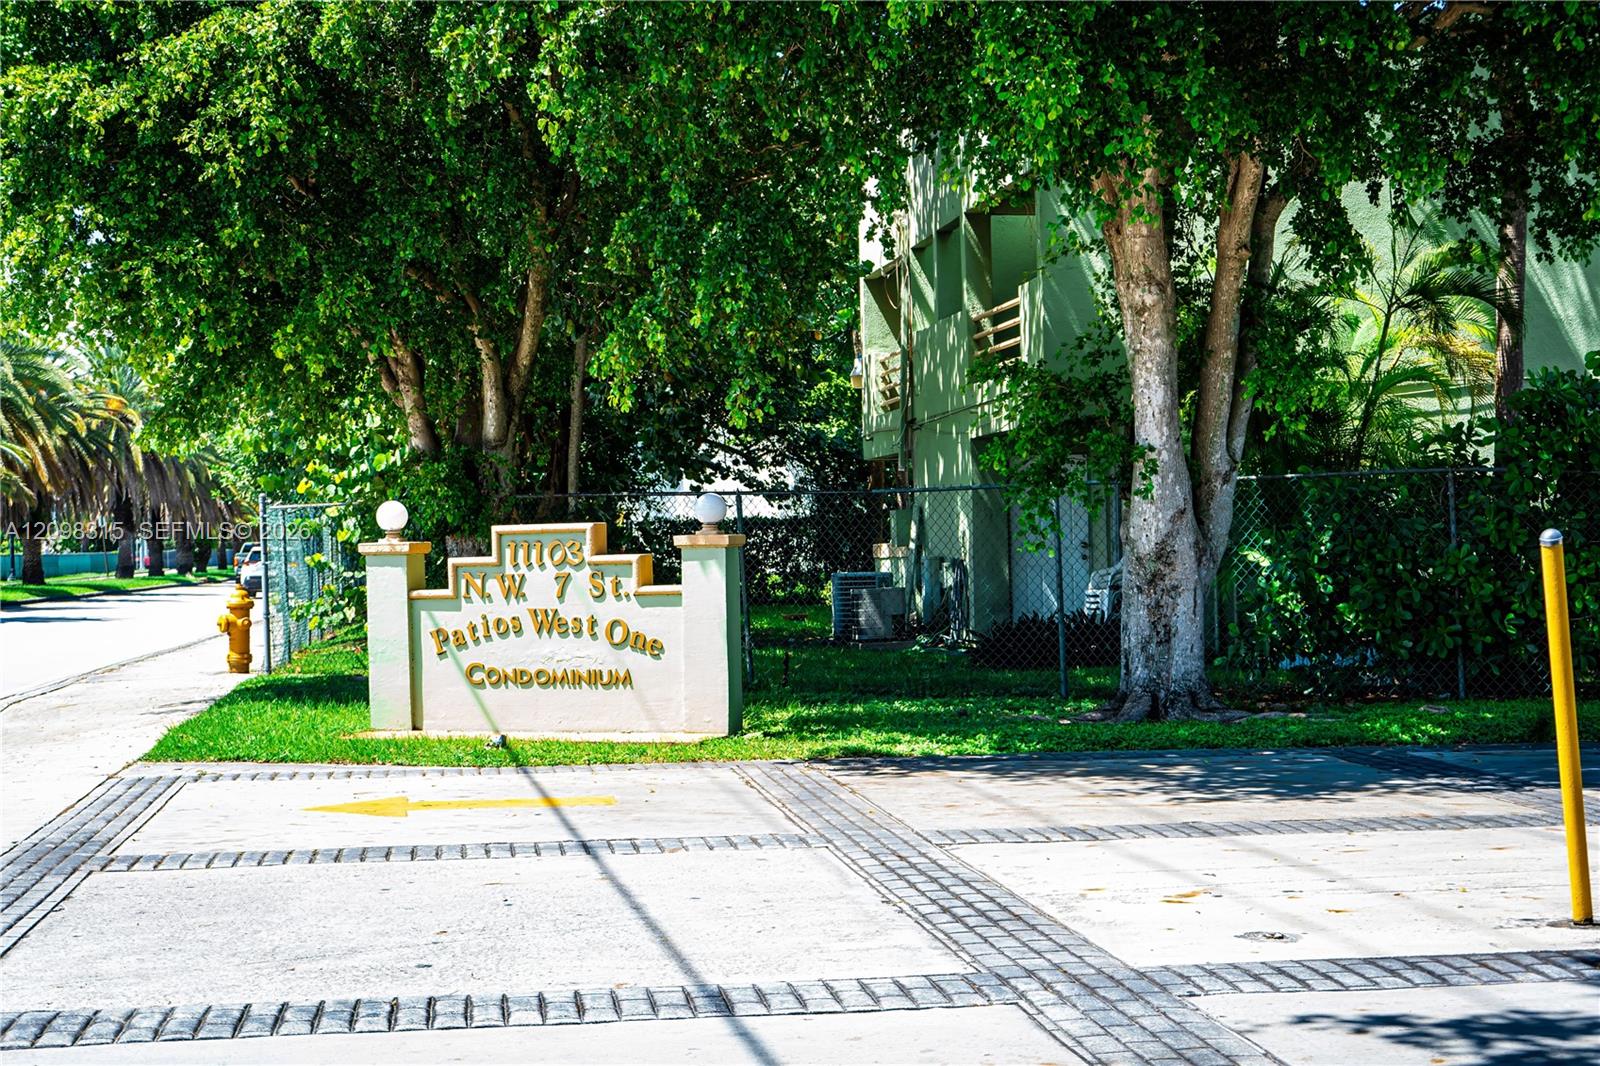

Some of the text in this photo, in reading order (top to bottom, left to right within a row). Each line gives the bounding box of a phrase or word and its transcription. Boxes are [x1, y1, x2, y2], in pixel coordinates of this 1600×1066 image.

[507, 539, 584, 568] 11103
[554, 572, 573, 599] 7
[589, 570, 631, 599] St.
[429, 607, 665, 658] Patios West One
